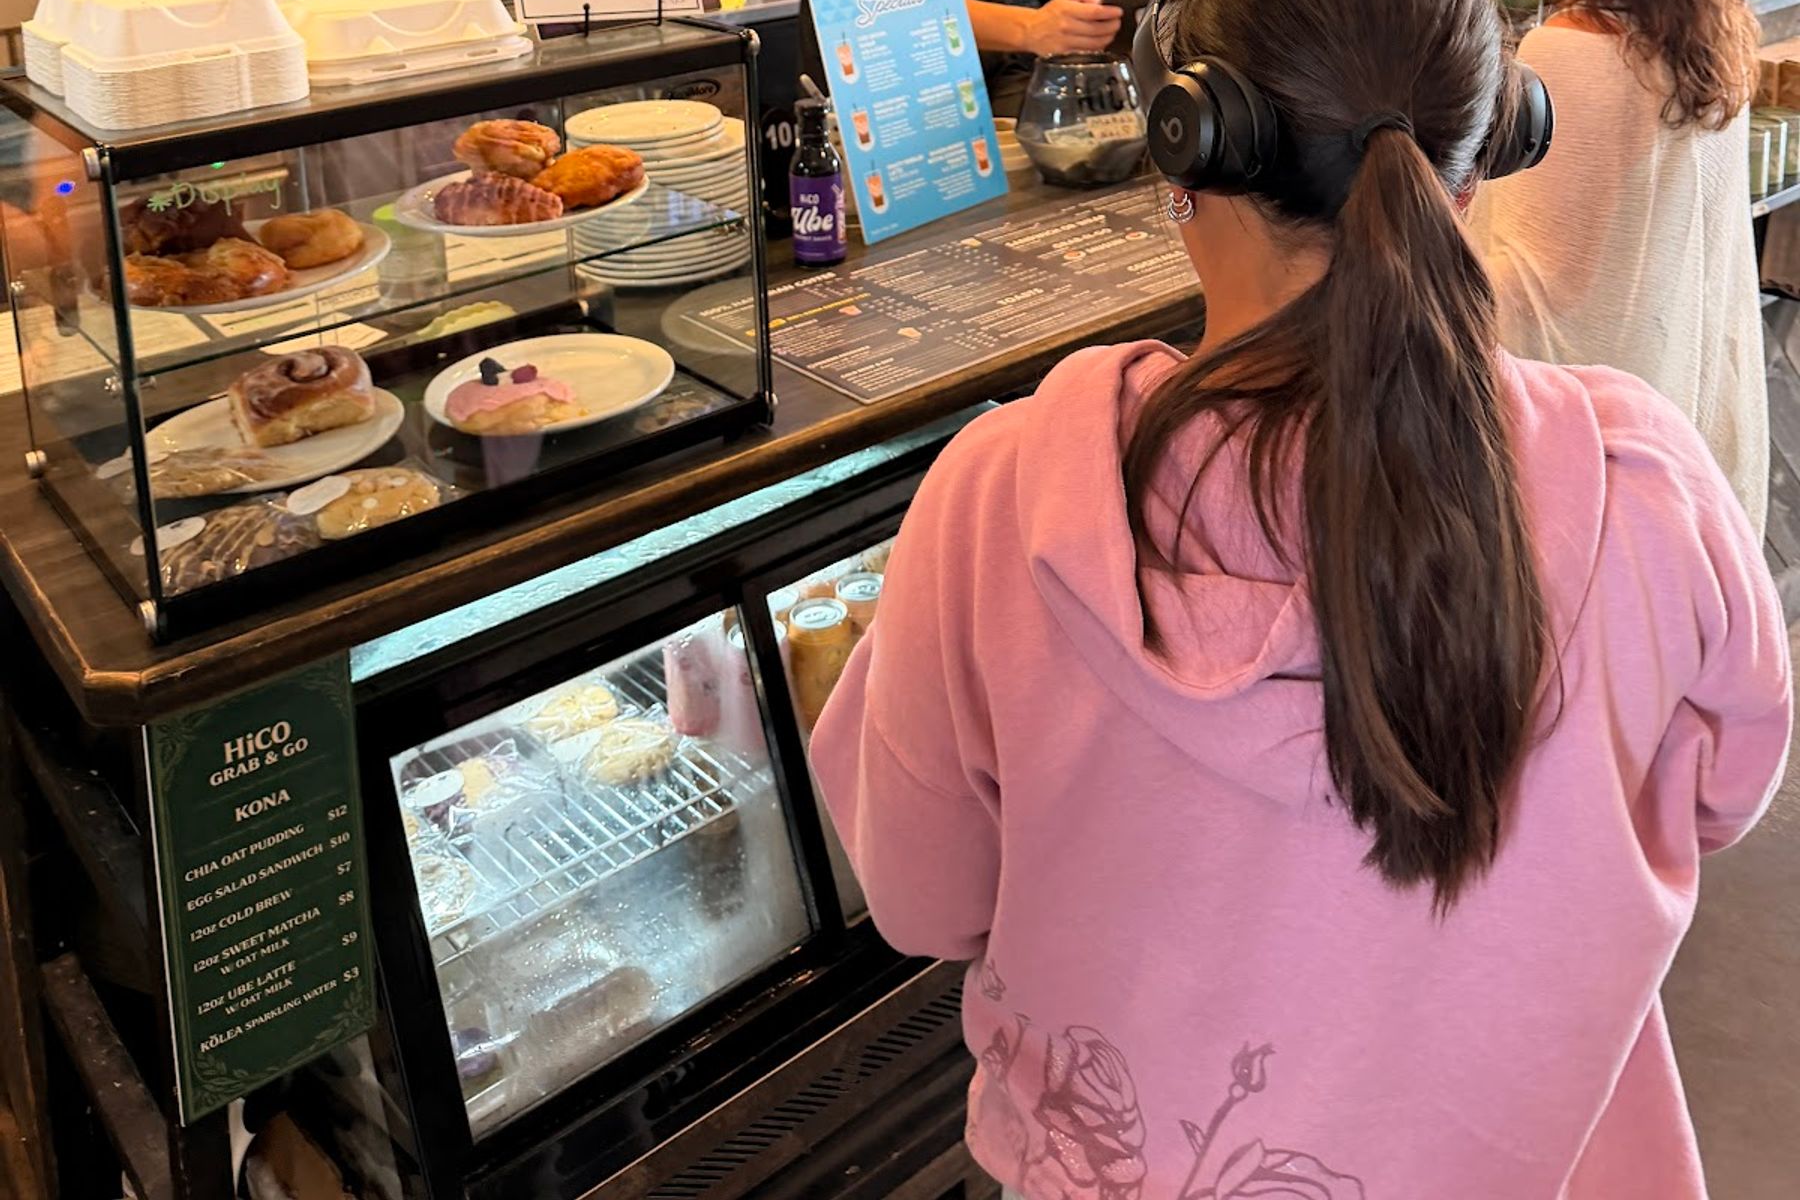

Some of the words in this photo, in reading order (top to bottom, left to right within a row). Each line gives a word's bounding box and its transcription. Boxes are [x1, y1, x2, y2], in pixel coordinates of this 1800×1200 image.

[791, 206, 833, 234] Ube
[209, 757, 261, 786] GRAB
[264, 751, 278, 765] &
[282, 738, 308, 757] GO
[223, 720, 292, 764] HiCO
[234, 788, 291, 822] KONA
[184, 861, 219, 882] CHIA
[221, 848, 248, 867] OAT
[250, 823, 305, 855] PUDDING
[327, 805, 348, 821] $12
[186, 892, 213, 912] EGG
[214, 873, 257, 898] SALAD
[259, 843, 323, 880] SANDWICH
[330, 832, 350, 848] $10
[218, 906, 253, 929] COLD
[255, 888, 293, 913] BREW
[336, 861, 352, 875] $7
[222, 931, 267, 960] SWEET
[268, 907, 321, 939] MATCHA
[338, 890, 355, 906] $8
[228, 980, 255, 1000] UBE
[257, 960, 297, 986] LATTE
[341, 931, 358, 946] $9
[235, 952, 258, 969] OAT
[260, 938, 290, 957] MILK
[240, 992, 262, 1008] OAT
[264, 977, 293, 996] MILK
[244, 999, 302, 1031] SPARKLING
[302, 979, 338, 1001] WATER
[343, 966, 360, 982] $3
